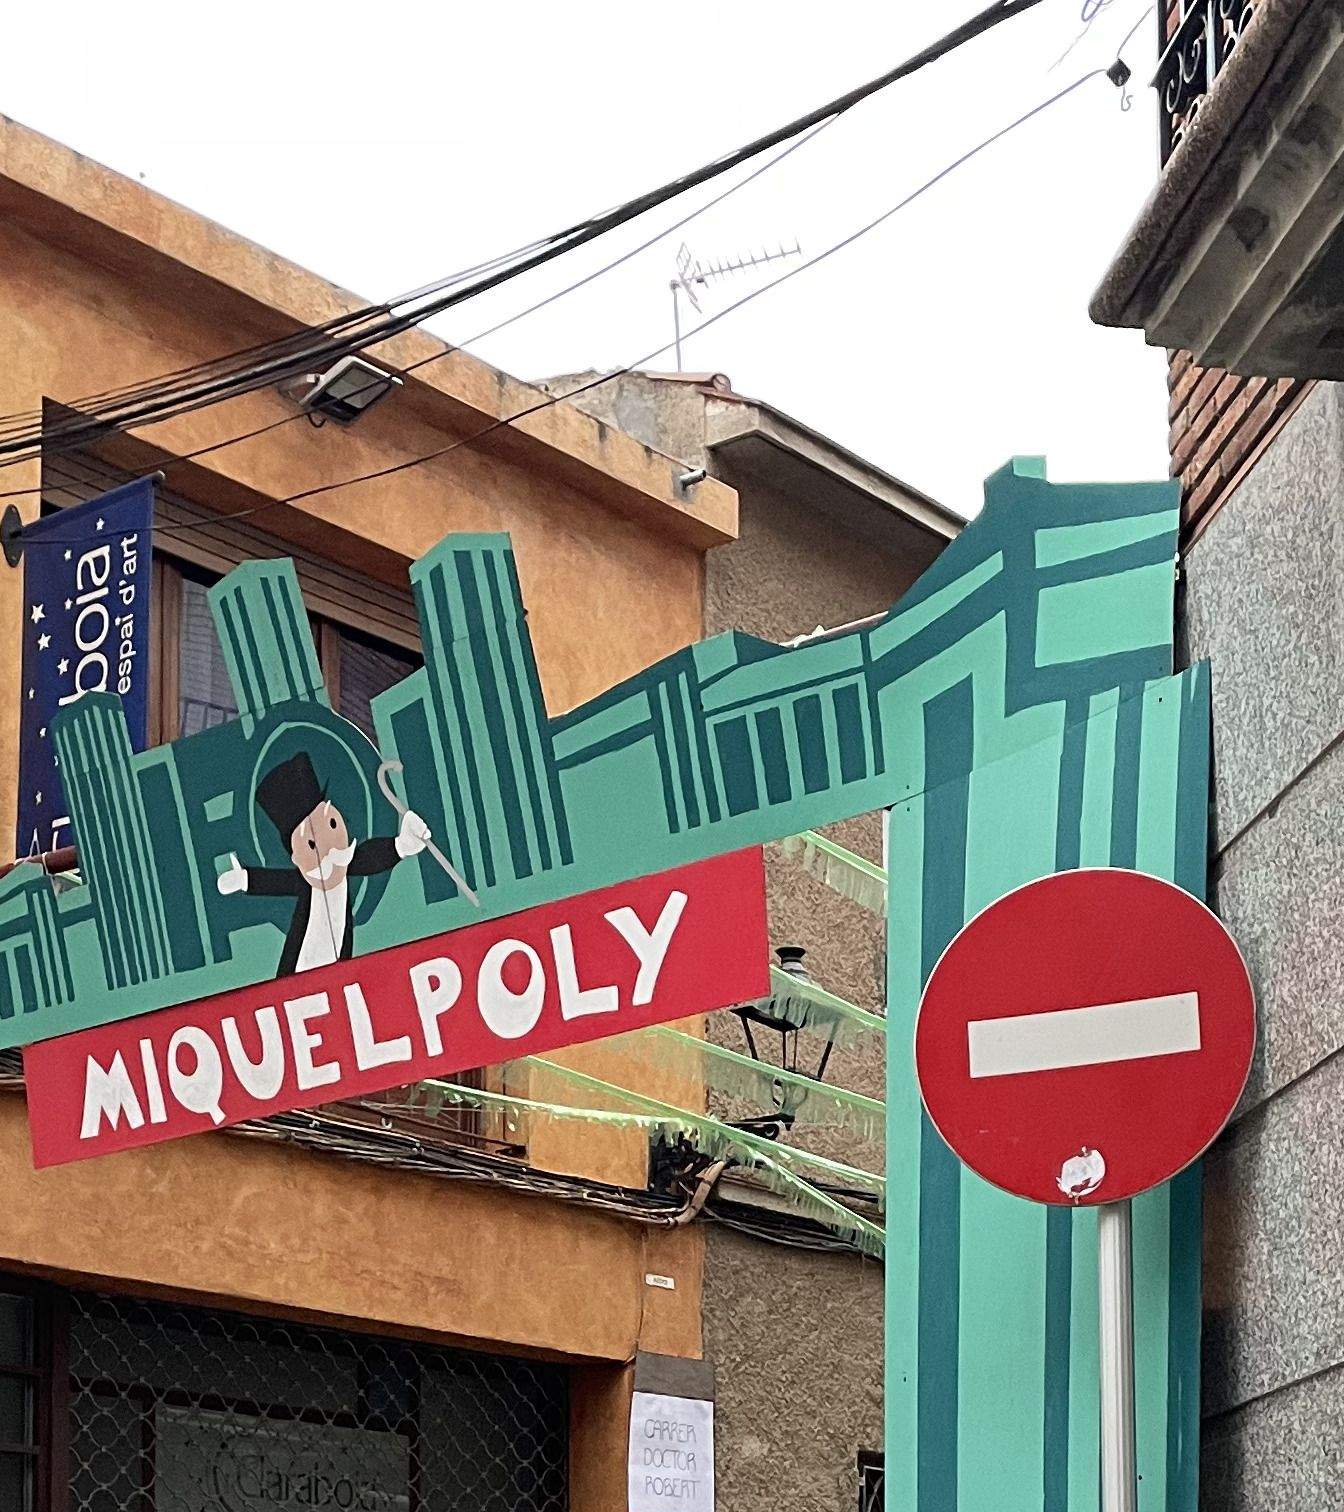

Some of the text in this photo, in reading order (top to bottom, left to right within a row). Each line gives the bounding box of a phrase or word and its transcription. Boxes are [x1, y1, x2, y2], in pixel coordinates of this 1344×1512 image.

[115, 534, 138, 695] espai d'art
[80, 890, 687, 1138] MIQUELPOLY
[644, 1419, 697, 1443] CARRER
[644, 1447, 697, 1473] DOCTOR
[645, 1475, 700, 1500] ROBERT
